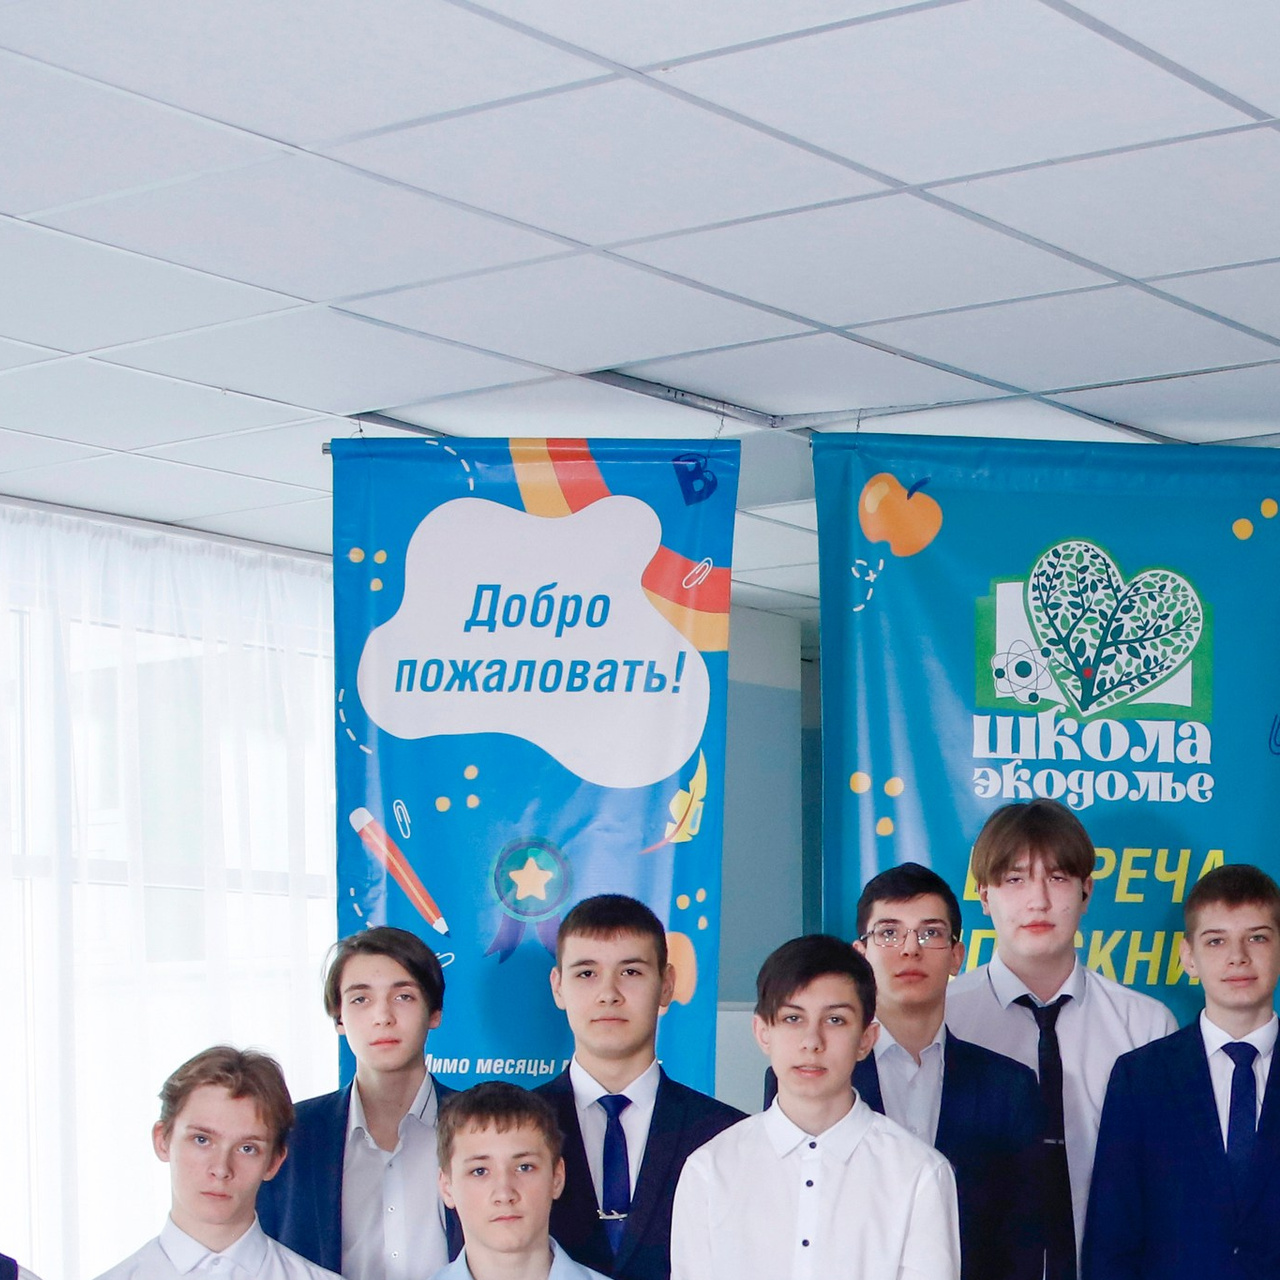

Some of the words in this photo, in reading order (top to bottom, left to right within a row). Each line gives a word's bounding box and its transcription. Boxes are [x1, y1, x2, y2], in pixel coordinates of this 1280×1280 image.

[463, 582, 611, 638] Добро
[394, 651, 687, 695] пожаловать!
[972, 759, 1215, 811] экодолье
[475, 1057, 555, 1077] месяцы
